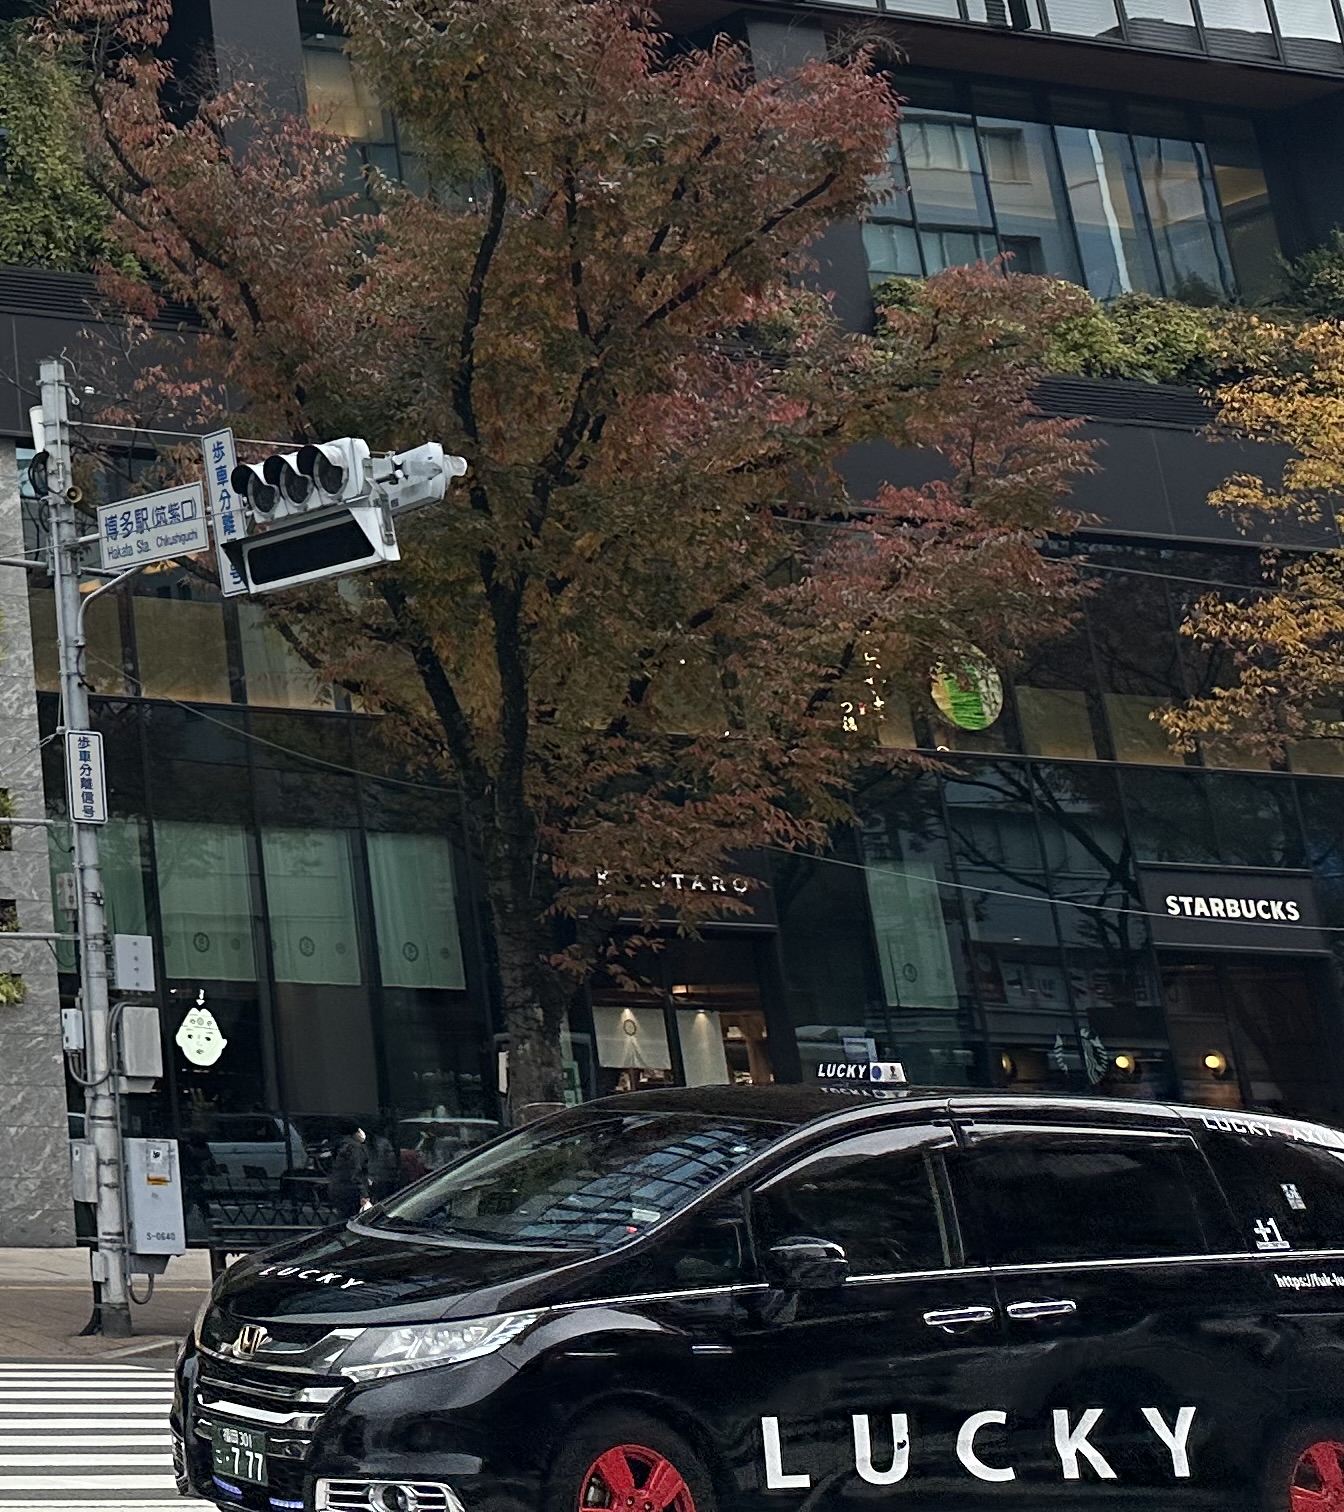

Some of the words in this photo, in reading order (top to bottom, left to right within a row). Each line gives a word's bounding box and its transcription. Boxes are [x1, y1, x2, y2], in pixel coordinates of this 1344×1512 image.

[212, 440, 242, 585] 歩車分離号
[107, 544, 133, 561] Hakata
[77, 735, 96, 818] 歩車分離信号
[1165, 895, 1302, 922] STARBUCKS
[817, 1063, 867, 1079] LUCKY
[1200, 1114, 1273, 1138] LUCKY
[146, 1231, 176, 1241] S-0640
[258, 1266, 366, 1291] LUCKY
[759, 1406, 1198, 1490] LUCKY
